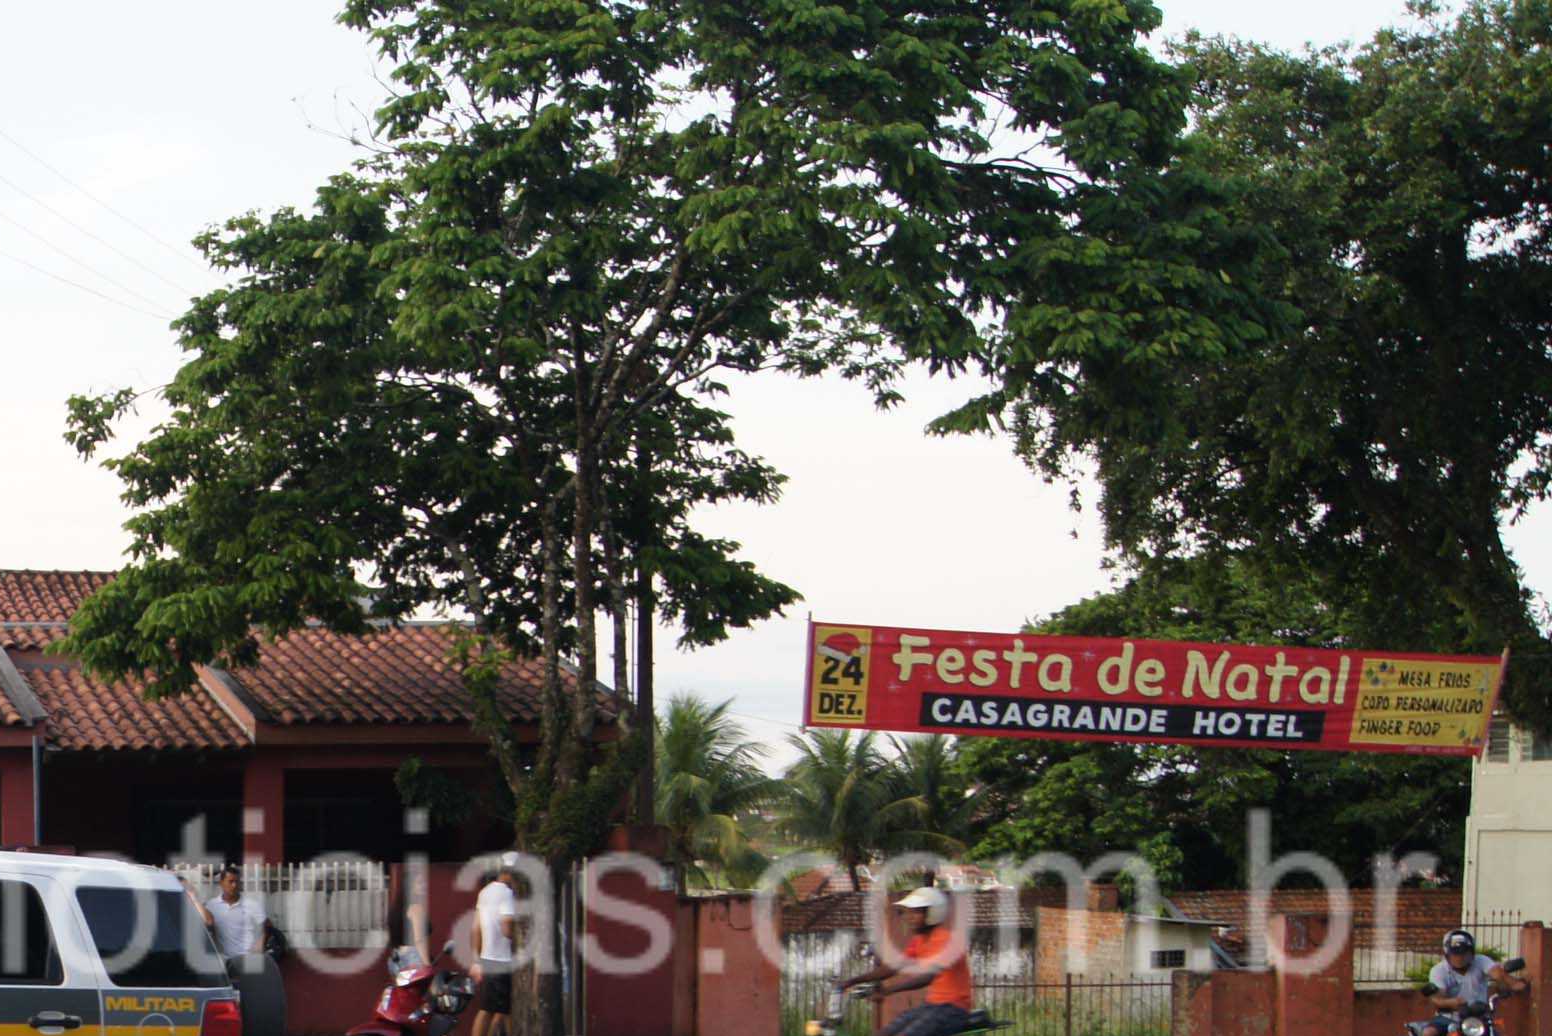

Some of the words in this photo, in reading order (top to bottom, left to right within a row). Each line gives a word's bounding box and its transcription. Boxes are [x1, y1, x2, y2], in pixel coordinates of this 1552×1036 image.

[820, 655, 864, 686] 24
[892, 633, 1073, 694] Festa
[1097, 641, 1166, 698] de
[1181, 650, 1351, 705] Natal
[1398, 671, 1432, 688] MESA
[1438, 671, 1472, 689] FRIOS
[818, 692, 863, 716] DEZ.
[931, 697, 1169, 734] CASAGRANDE
[1192, 711, 1304, 739] HOTEL
[1358, 719, 1402, 736] FINGER
[105, 995, 196, 1013] MILITAR
